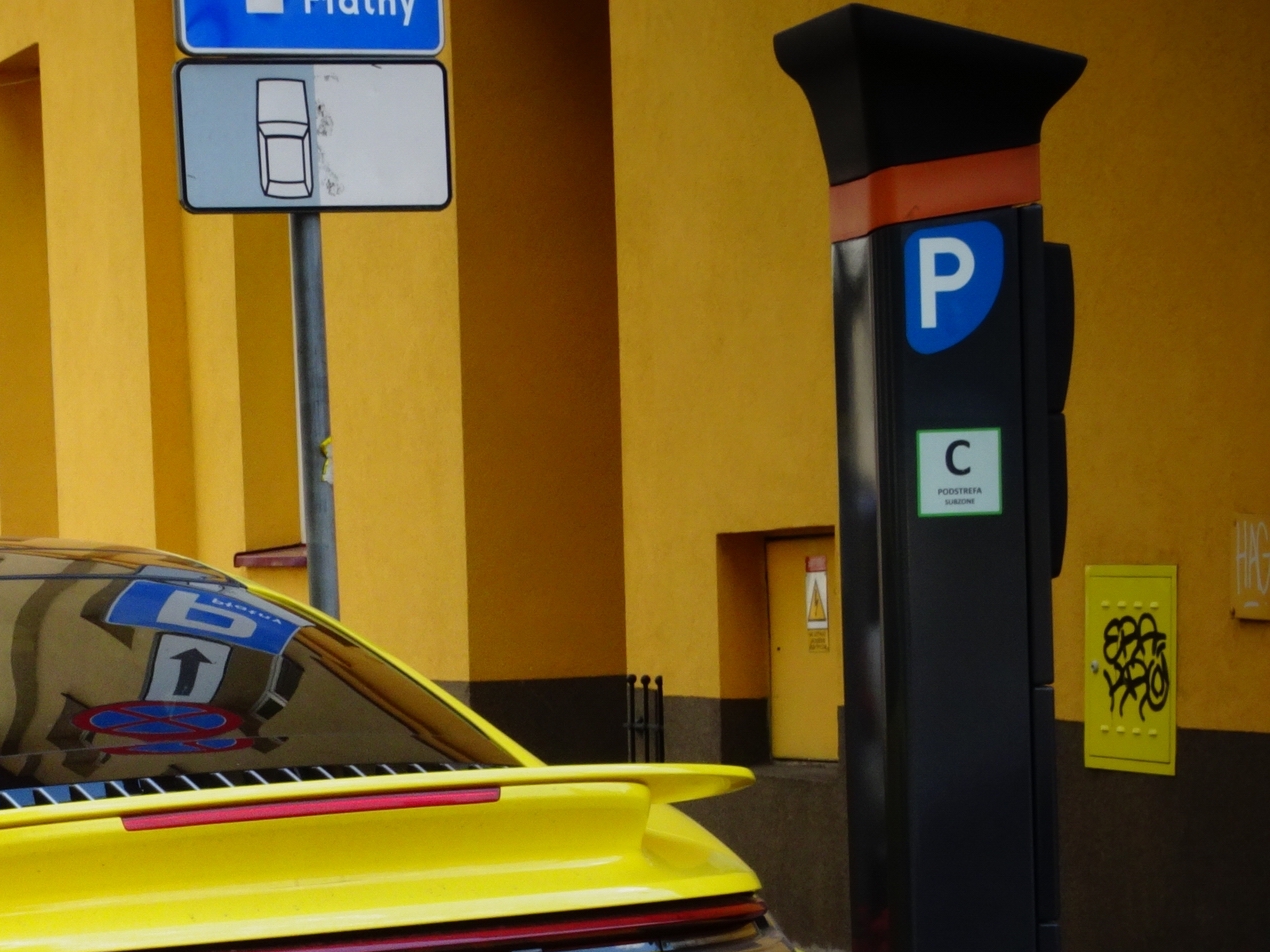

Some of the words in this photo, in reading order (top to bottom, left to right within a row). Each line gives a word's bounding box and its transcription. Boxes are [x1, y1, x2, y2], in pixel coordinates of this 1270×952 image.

[919, 237, 976, 329] P
[945, 439, 971, 476] C
[937, 487, 982, 496] PODSTREFA
[944, 498, 975, 506] SUBZONE
